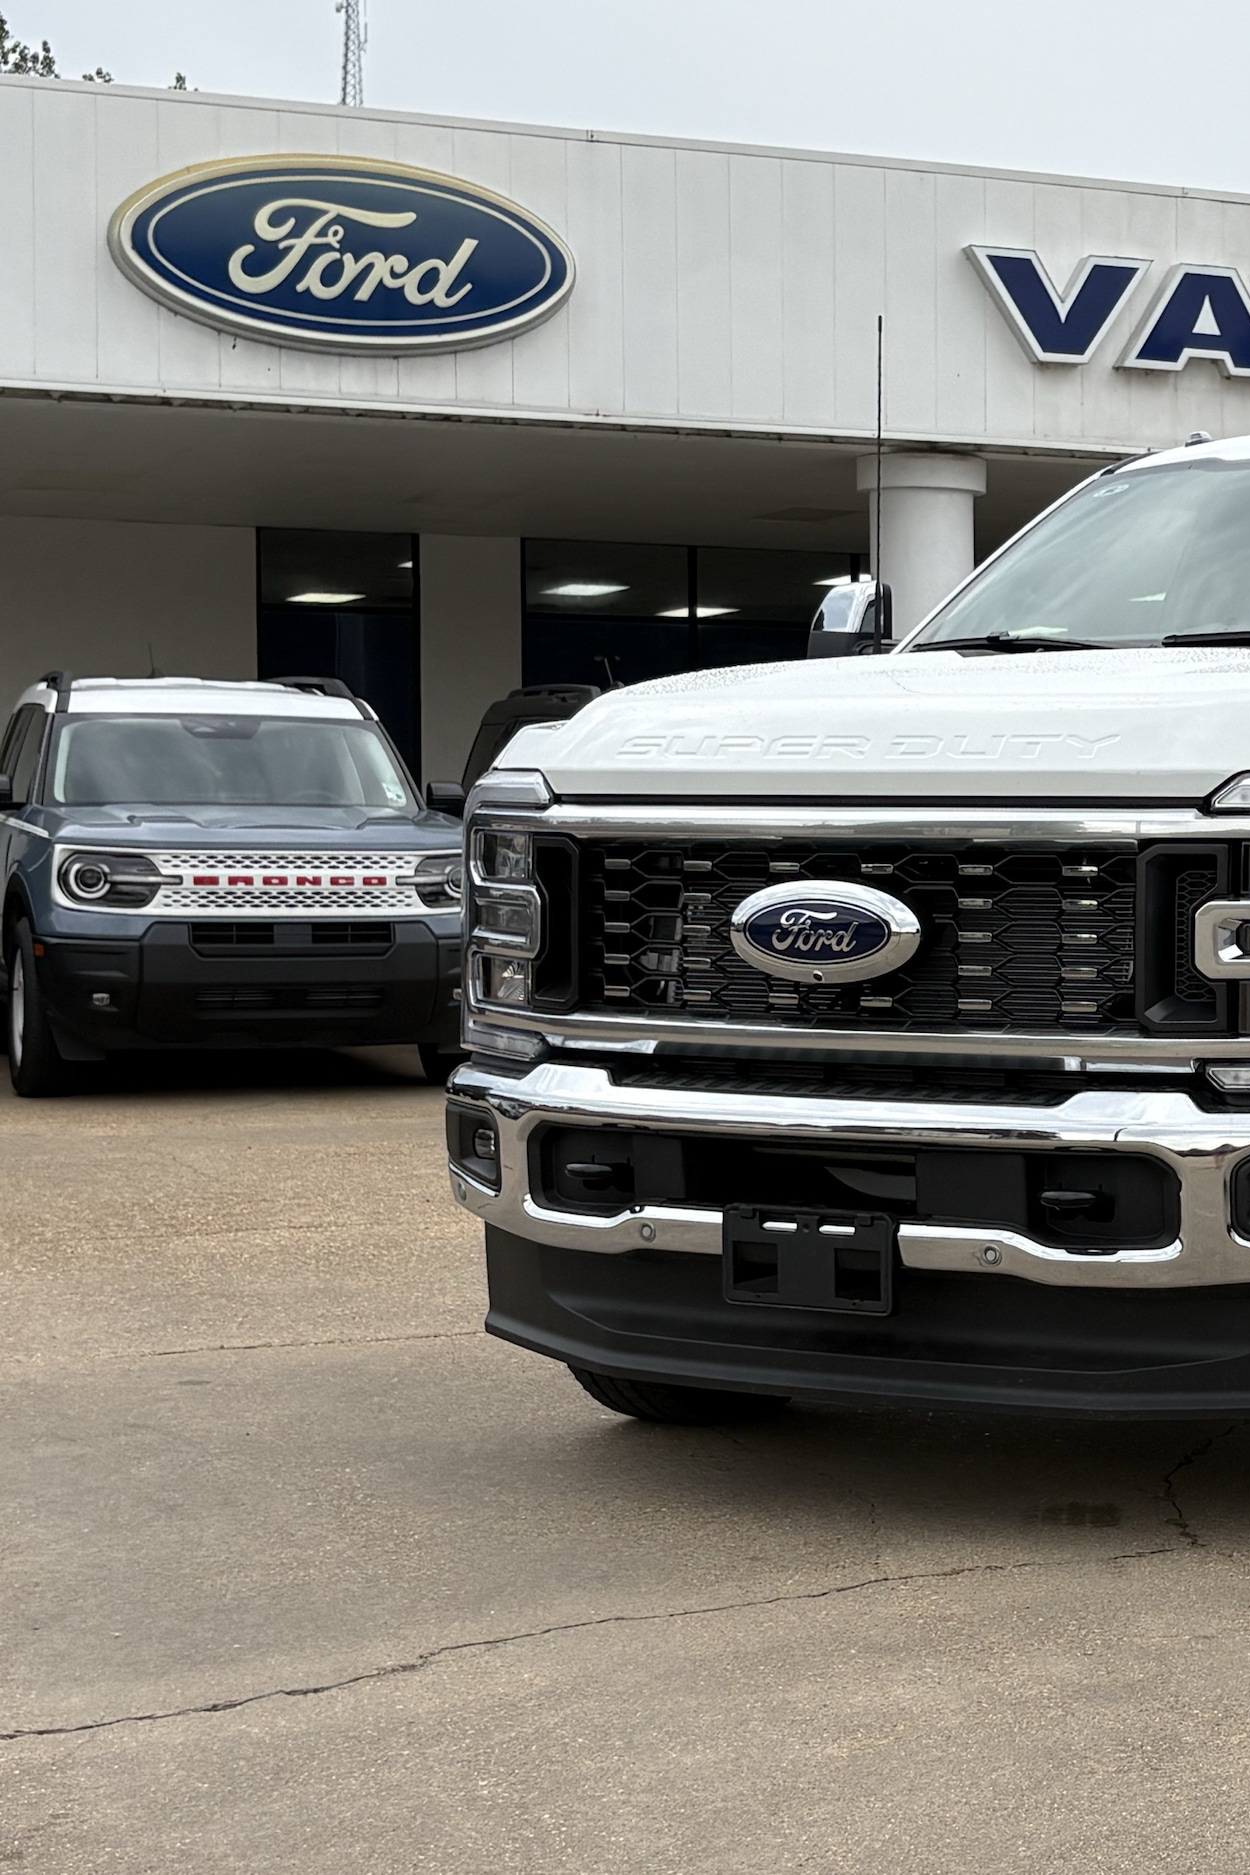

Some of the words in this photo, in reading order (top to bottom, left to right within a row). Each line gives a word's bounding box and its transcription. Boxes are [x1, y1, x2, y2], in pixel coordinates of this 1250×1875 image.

[228, 197, 478, 309] Ford
[615, 735, 872, 760] SUPER
[884, 733, 1121, 760] DUTY
[193, 875, 388, 886] BRONCO
[772, 908, 860, 955] Ford
